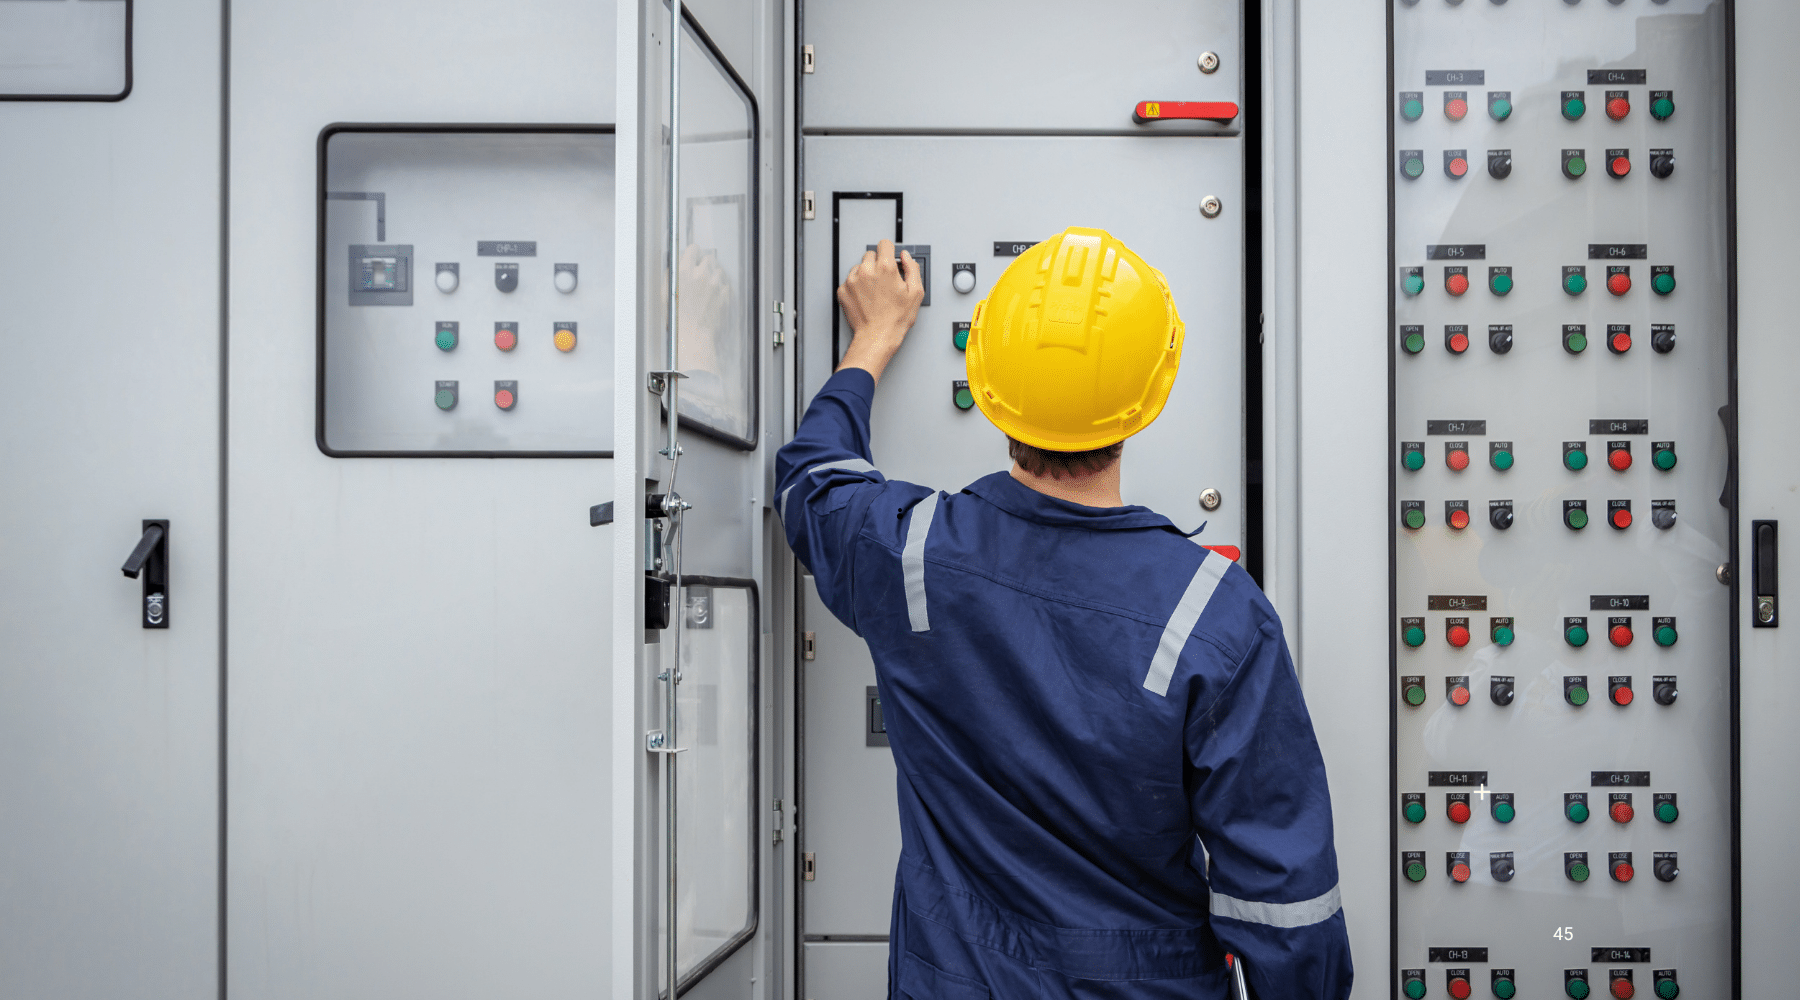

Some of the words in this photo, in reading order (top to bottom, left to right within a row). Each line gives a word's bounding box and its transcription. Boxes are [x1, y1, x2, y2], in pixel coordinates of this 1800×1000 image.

[1446, 73, 1464, 81] CH-3
[1608, 73, 1625, 81] CH-4
[1448, 248, 1464, 256] CH-5
[1609, 248, 1625, 256] CH-6
[1448, 423, 1465, 431] CH-7
[1610, 423, 1626, 431] CH-8
[1449, 599, 1465, 607] CH-9
[1610, 599, 1629, 607] CH-10
[1449, 775, 1467, 783] CH-11
[1611, 775, 1630, 783] CH-12
[1449, 951, 1468, 959] CH-13
